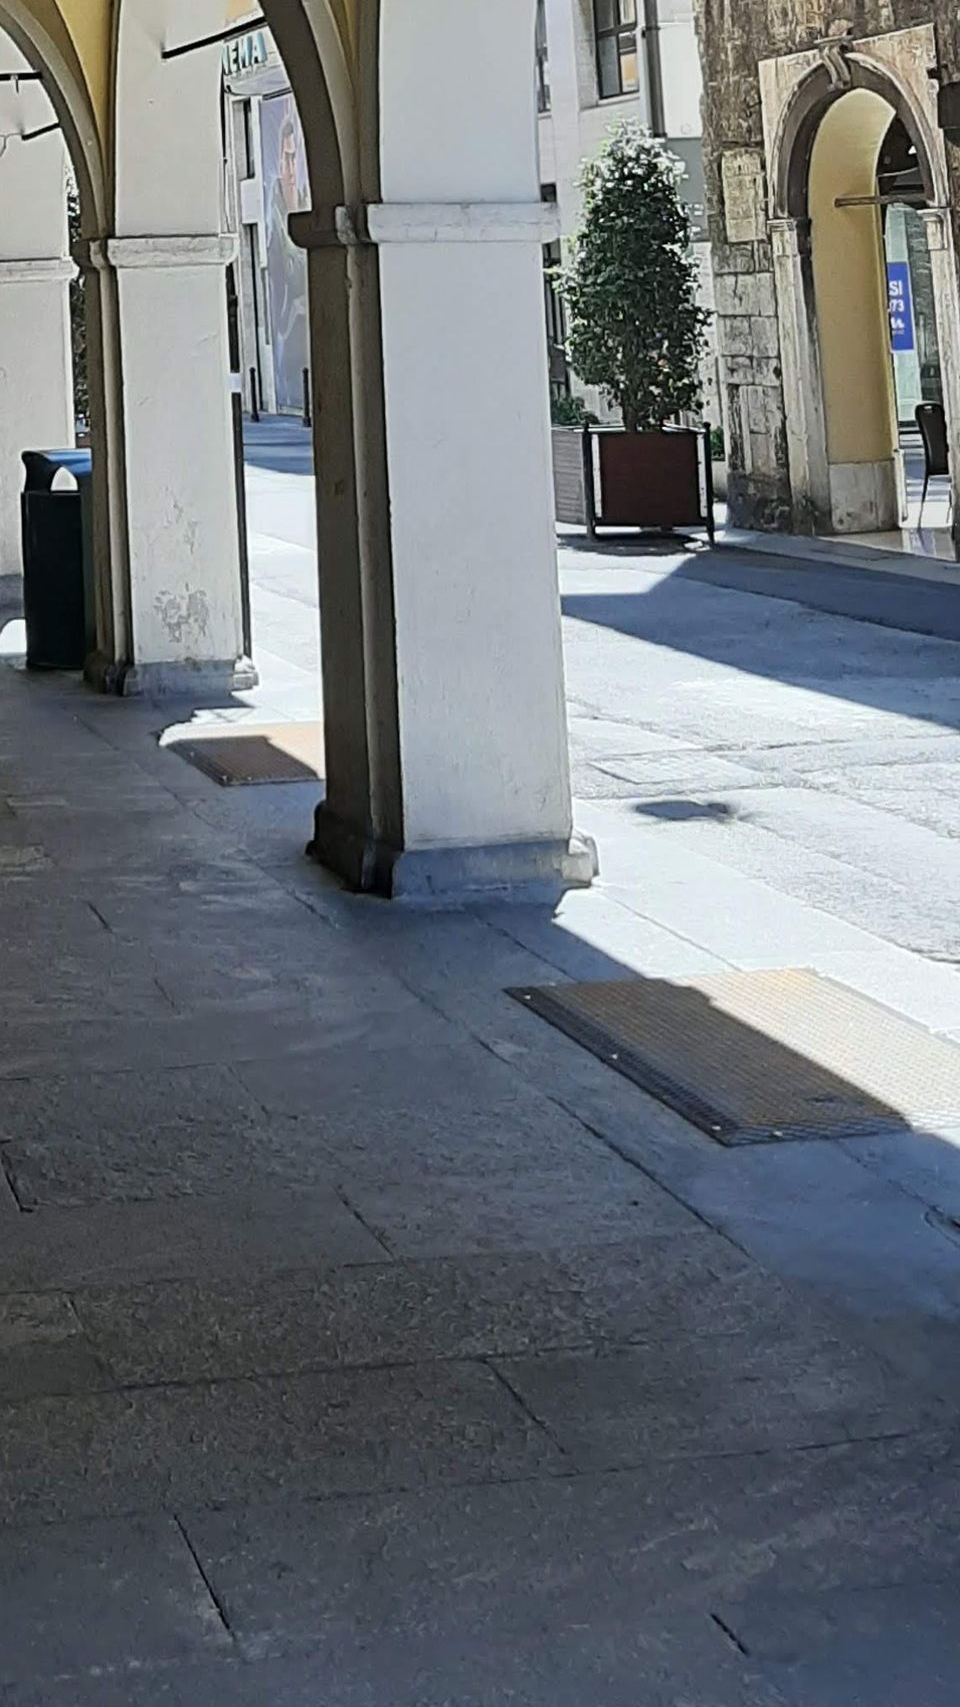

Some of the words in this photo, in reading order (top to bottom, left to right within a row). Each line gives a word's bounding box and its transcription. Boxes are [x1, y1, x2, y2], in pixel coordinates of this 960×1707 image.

[221, 32, 268, 75] NEMA
[889, 280, 903, 296] SI
[888, 299, 905, 312] 73
